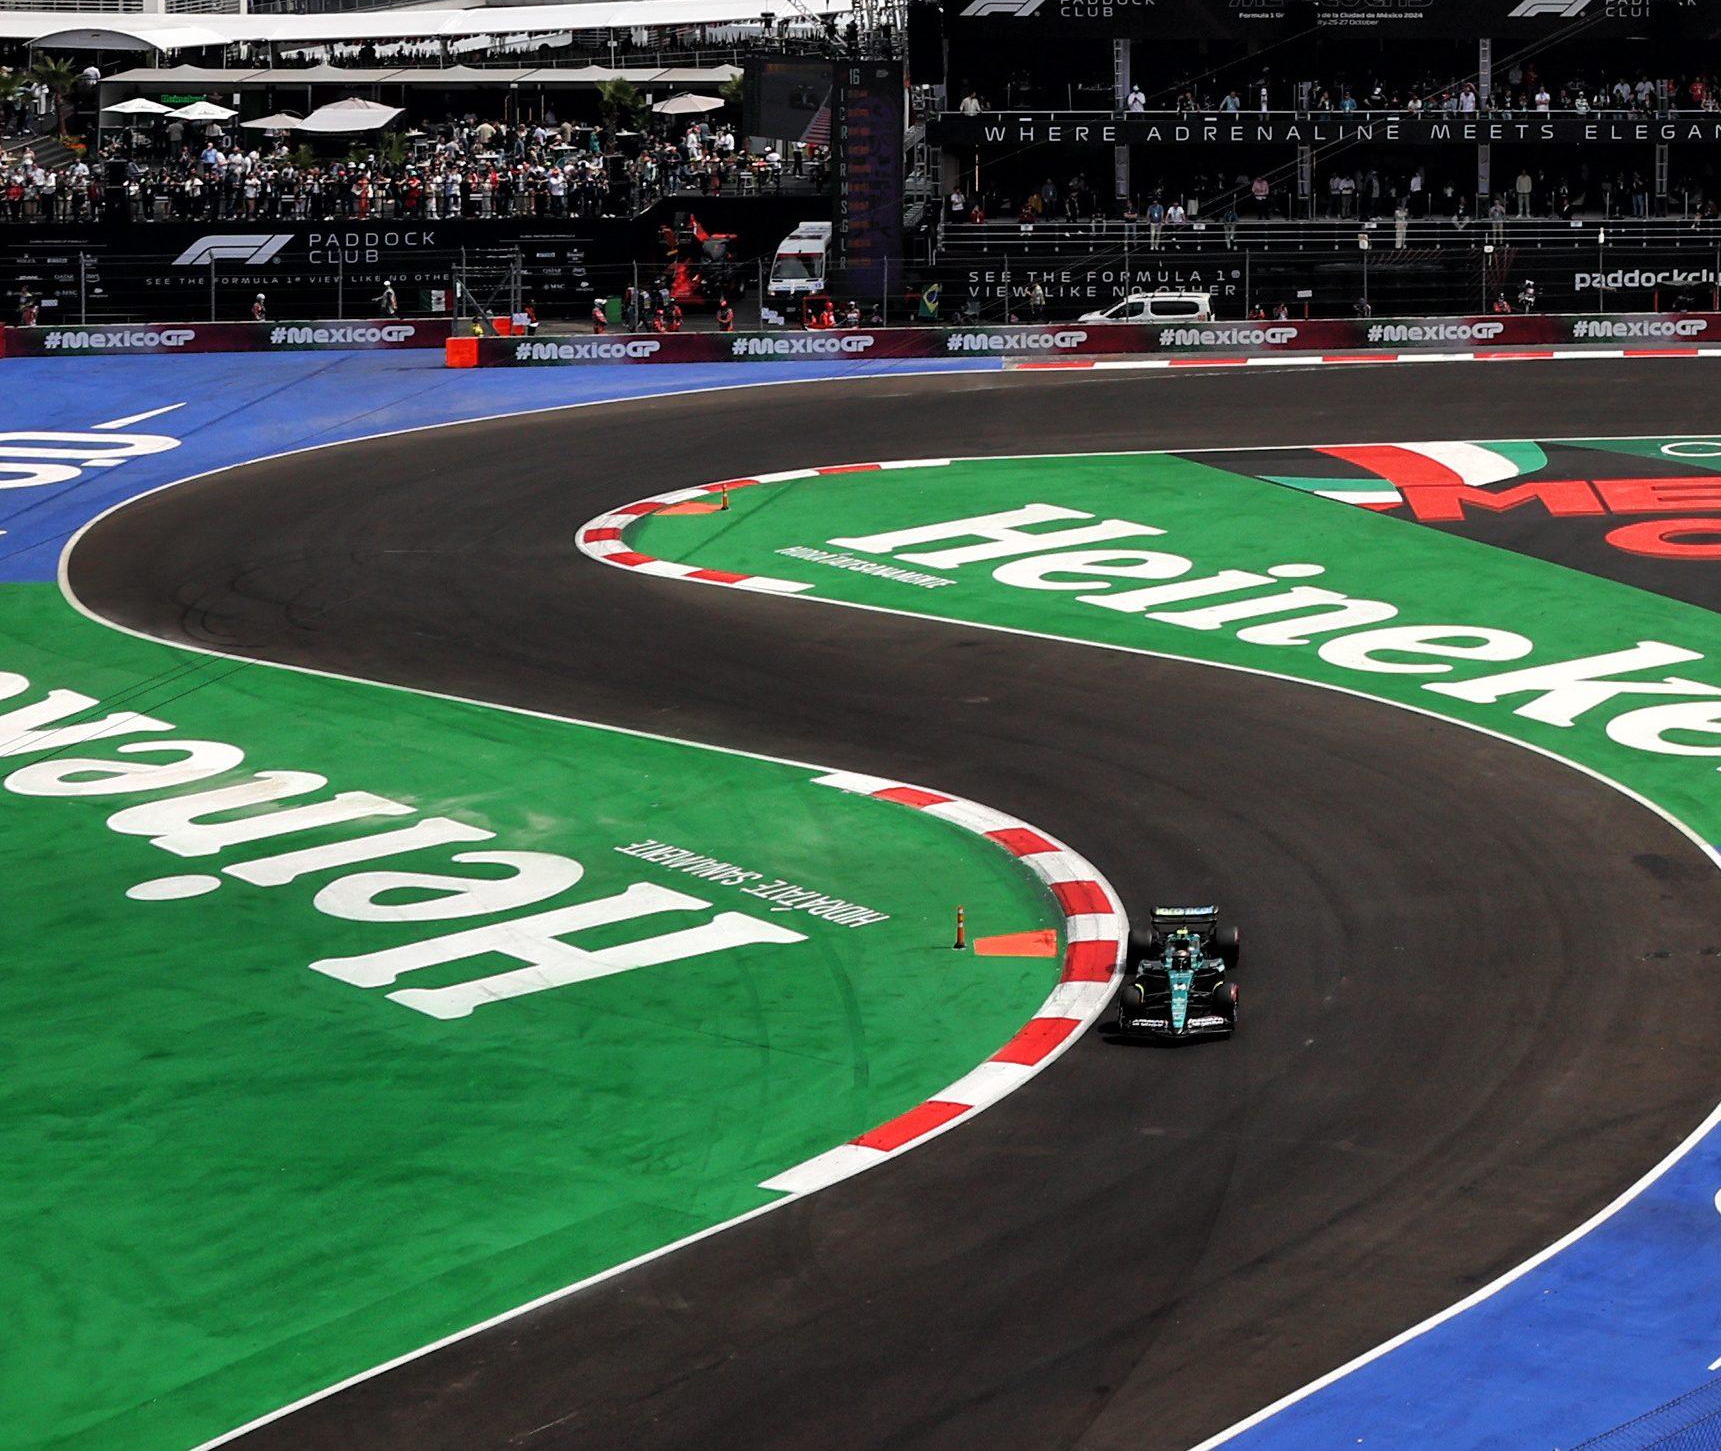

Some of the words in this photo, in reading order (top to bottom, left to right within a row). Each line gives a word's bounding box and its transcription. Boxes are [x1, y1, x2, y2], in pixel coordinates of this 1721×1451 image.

[1060, 7, 1114, 17] CLUB
[985, 126, 1116, 141] WHERE
[1147, 125, 1400, 141] ADRENALINE
[1431, 125, 1554, 140] MEETS
[309, 232, 436, 247] PADDOCK
[309, 249, 380, 264] CLUB
[146, 278, 171, 286] SEE
[180, 277, 205, 285] THE
[214, 276, 279, 285] FORMULA
[352, 275, 381, 283] LIKE
[969, 271, 1011, 283] SEE
[1027, 271, 1071, 283] THE
[1087, 271, 1201, 283] FORMULA
[969, 286, 1028, 298] VIEW
[1045, 286, 1097, 297] LIKE
[270, 324, 416, 345] #MexicoGP
[1159, 326, 1298, 347] #MexicoGP
[1368, 322, 1504, 342] #MexicoGP
[1573, 319, 1708, 338] #MexicoGP
[44, 329, 195, 350] #MexicoGP
[732, 335, 875, 355] #MexicoGP
[947, 331, 1088, 351] #MexicoGP
[516, 340, 661, 360] #MexicoGP
